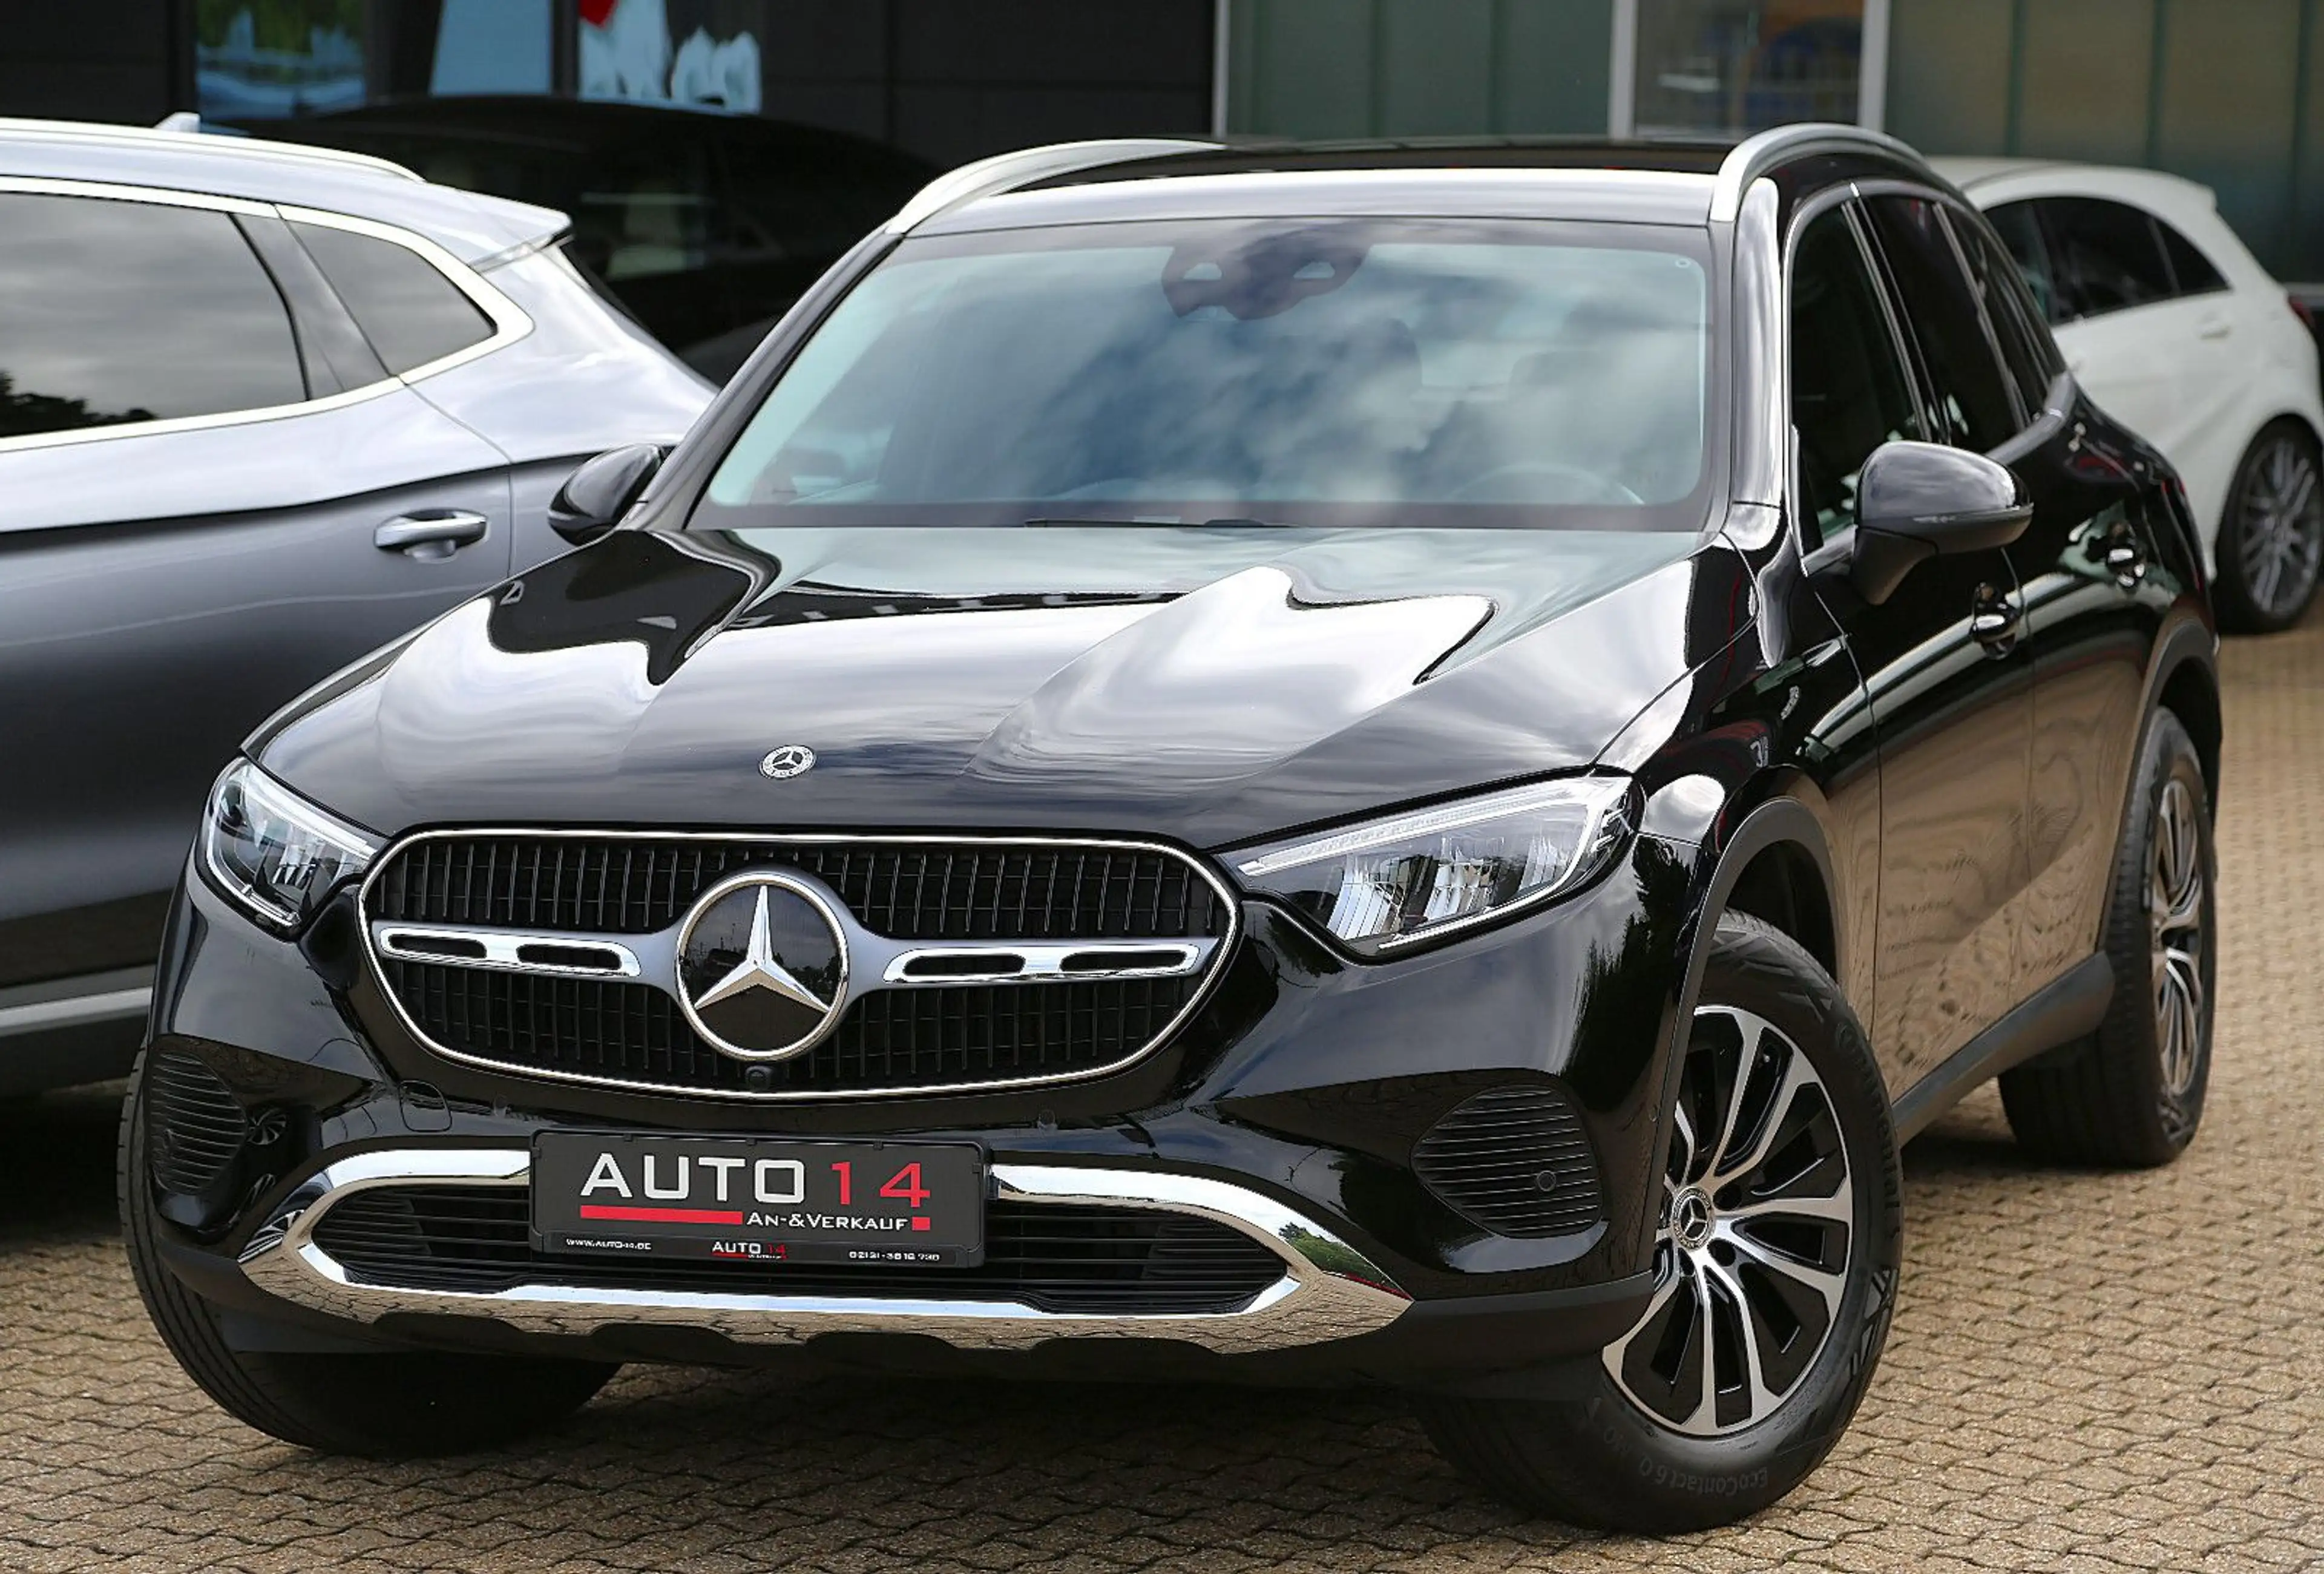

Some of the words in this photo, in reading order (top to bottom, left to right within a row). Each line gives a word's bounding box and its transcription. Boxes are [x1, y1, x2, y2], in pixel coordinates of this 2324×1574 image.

[580, 1152, 804, 1204] AUTO
[832, 1161, 931, 1208] 14
[712, 1241, 761, 1254] AUTO
